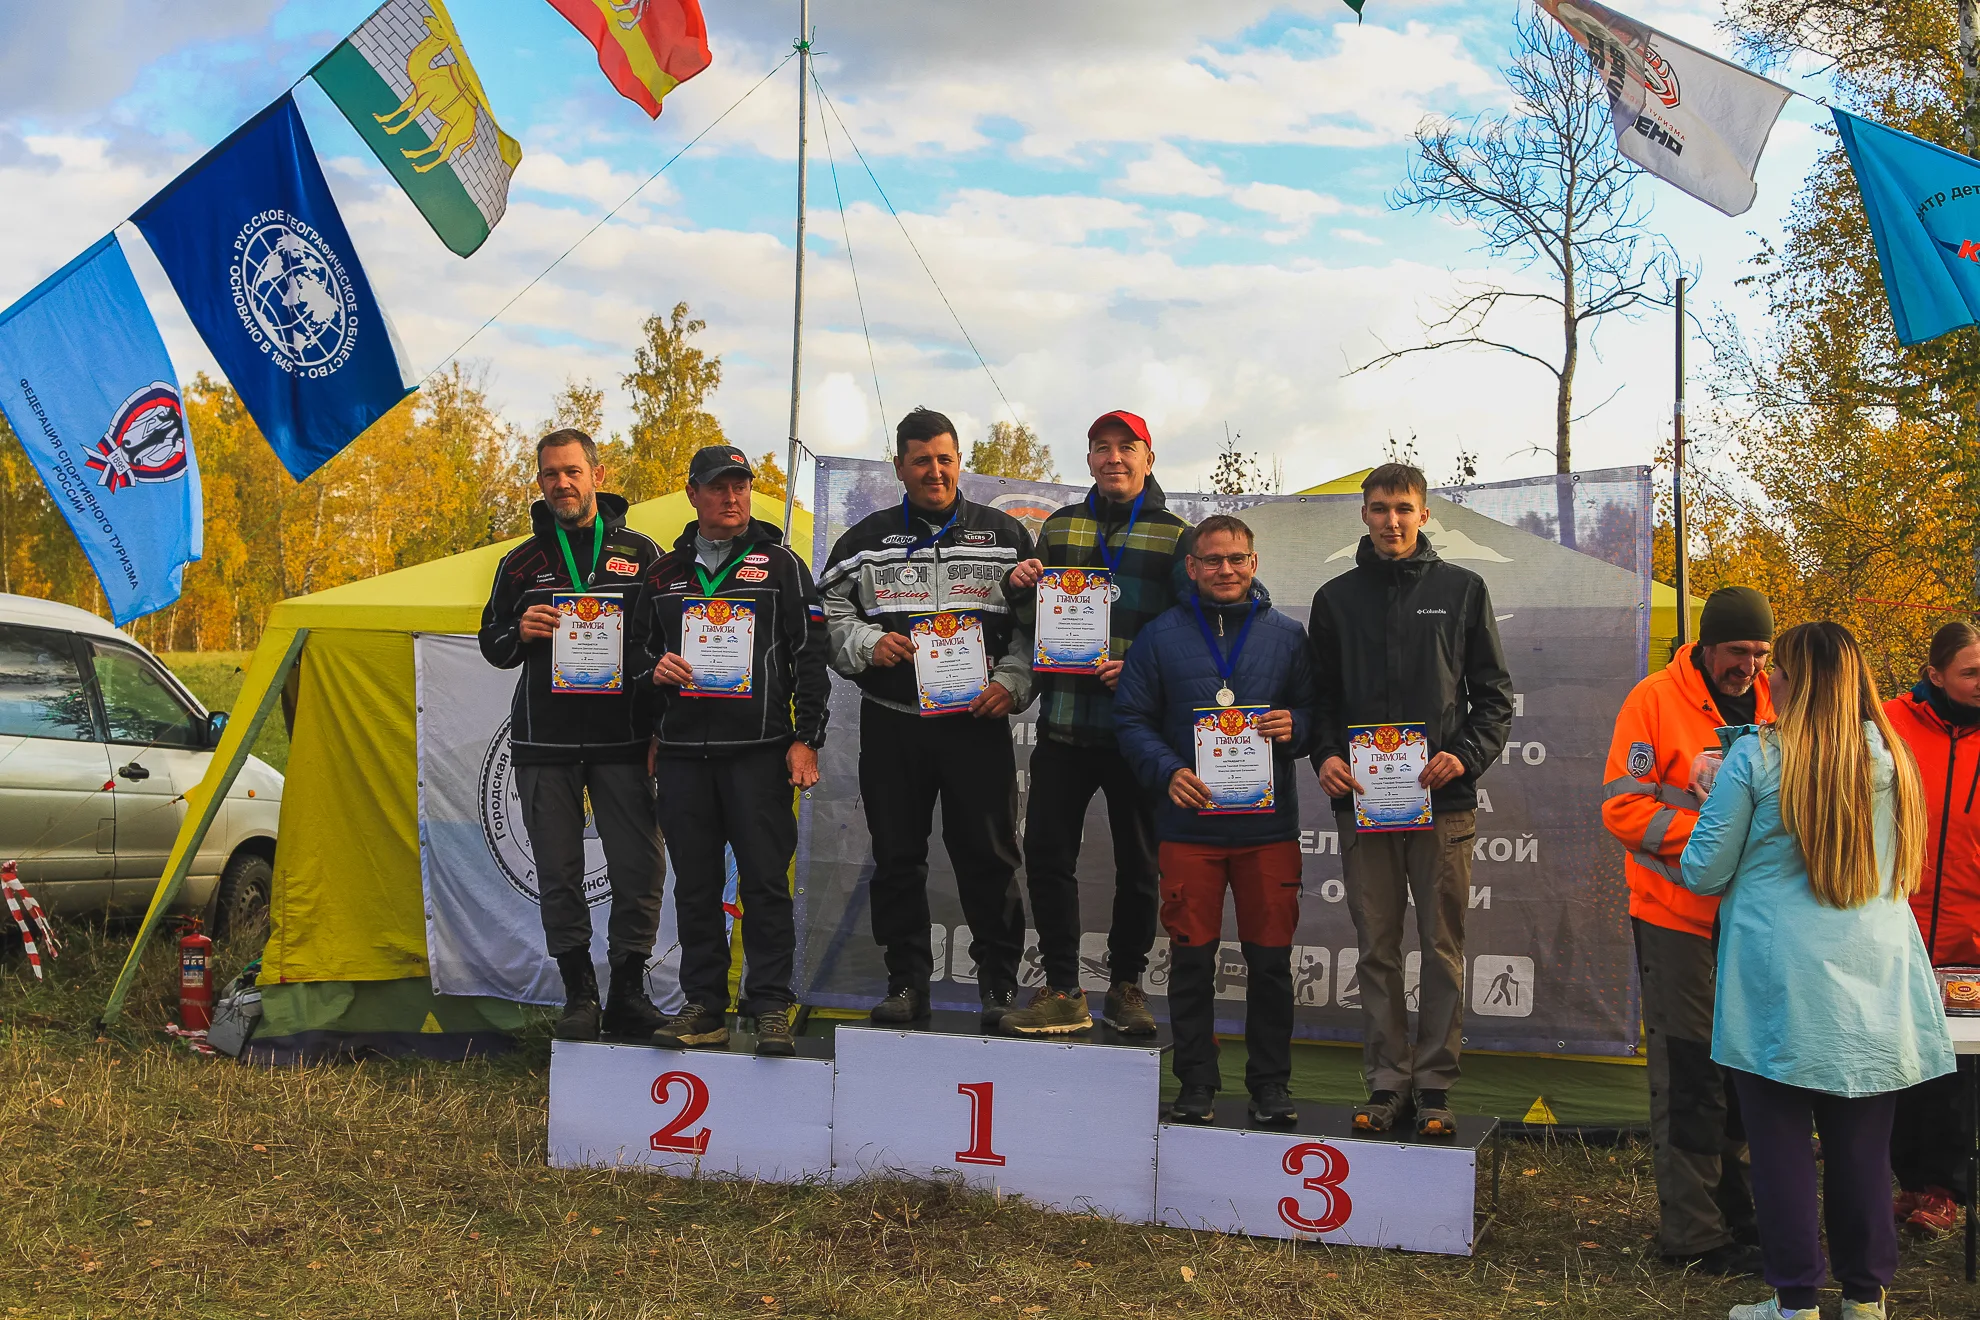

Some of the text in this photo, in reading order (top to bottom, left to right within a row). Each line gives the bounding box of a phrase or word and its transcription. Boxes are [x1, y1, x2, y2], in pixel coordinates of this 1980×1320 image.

[1631, 115, 1683, 157] ЕНО
[1916, 184, 1980, 223] ентр дет
[234, 209, 359, 379] РУССКОЕ ГЕОГРАФИЧЕСКОЕ ОБЩЕСТВО
[230, 265, 293, 373] ОСНОВАНО В 1845
[111, 453, 125, 472] 1895
[19, 378, 139, 590] ФЕДЕРАЦИЯ СПОРТИВНОГО ТУРИЗМА
[52, 466, 86, 514] РОССИИ
[608, 562, 637, 573] RED
[738, 570, 765, 578] RED
[947, 564, 1004, 581] SPEED
[875, 584, 993, 600] Racing Stuff
[1056, 595, 1091, 604] ГРАМОТА
[572, 621, 605, 630] ГРАМОТА
[702, 625, 735, 633] ГРАМОТА
[931, 637, 965, 648] ГРАМОТА
[1216, 736, 1251, 745] ГРАМОТА
[1371, 752, 1407, 762] ГРАМОТА
[491, 752, 509, 841] Городская
[650, 1071, 713, 1154] 2
[955, 1081, 1006, 1166] 1
[1278, 1142, 1353, 1233] 3
